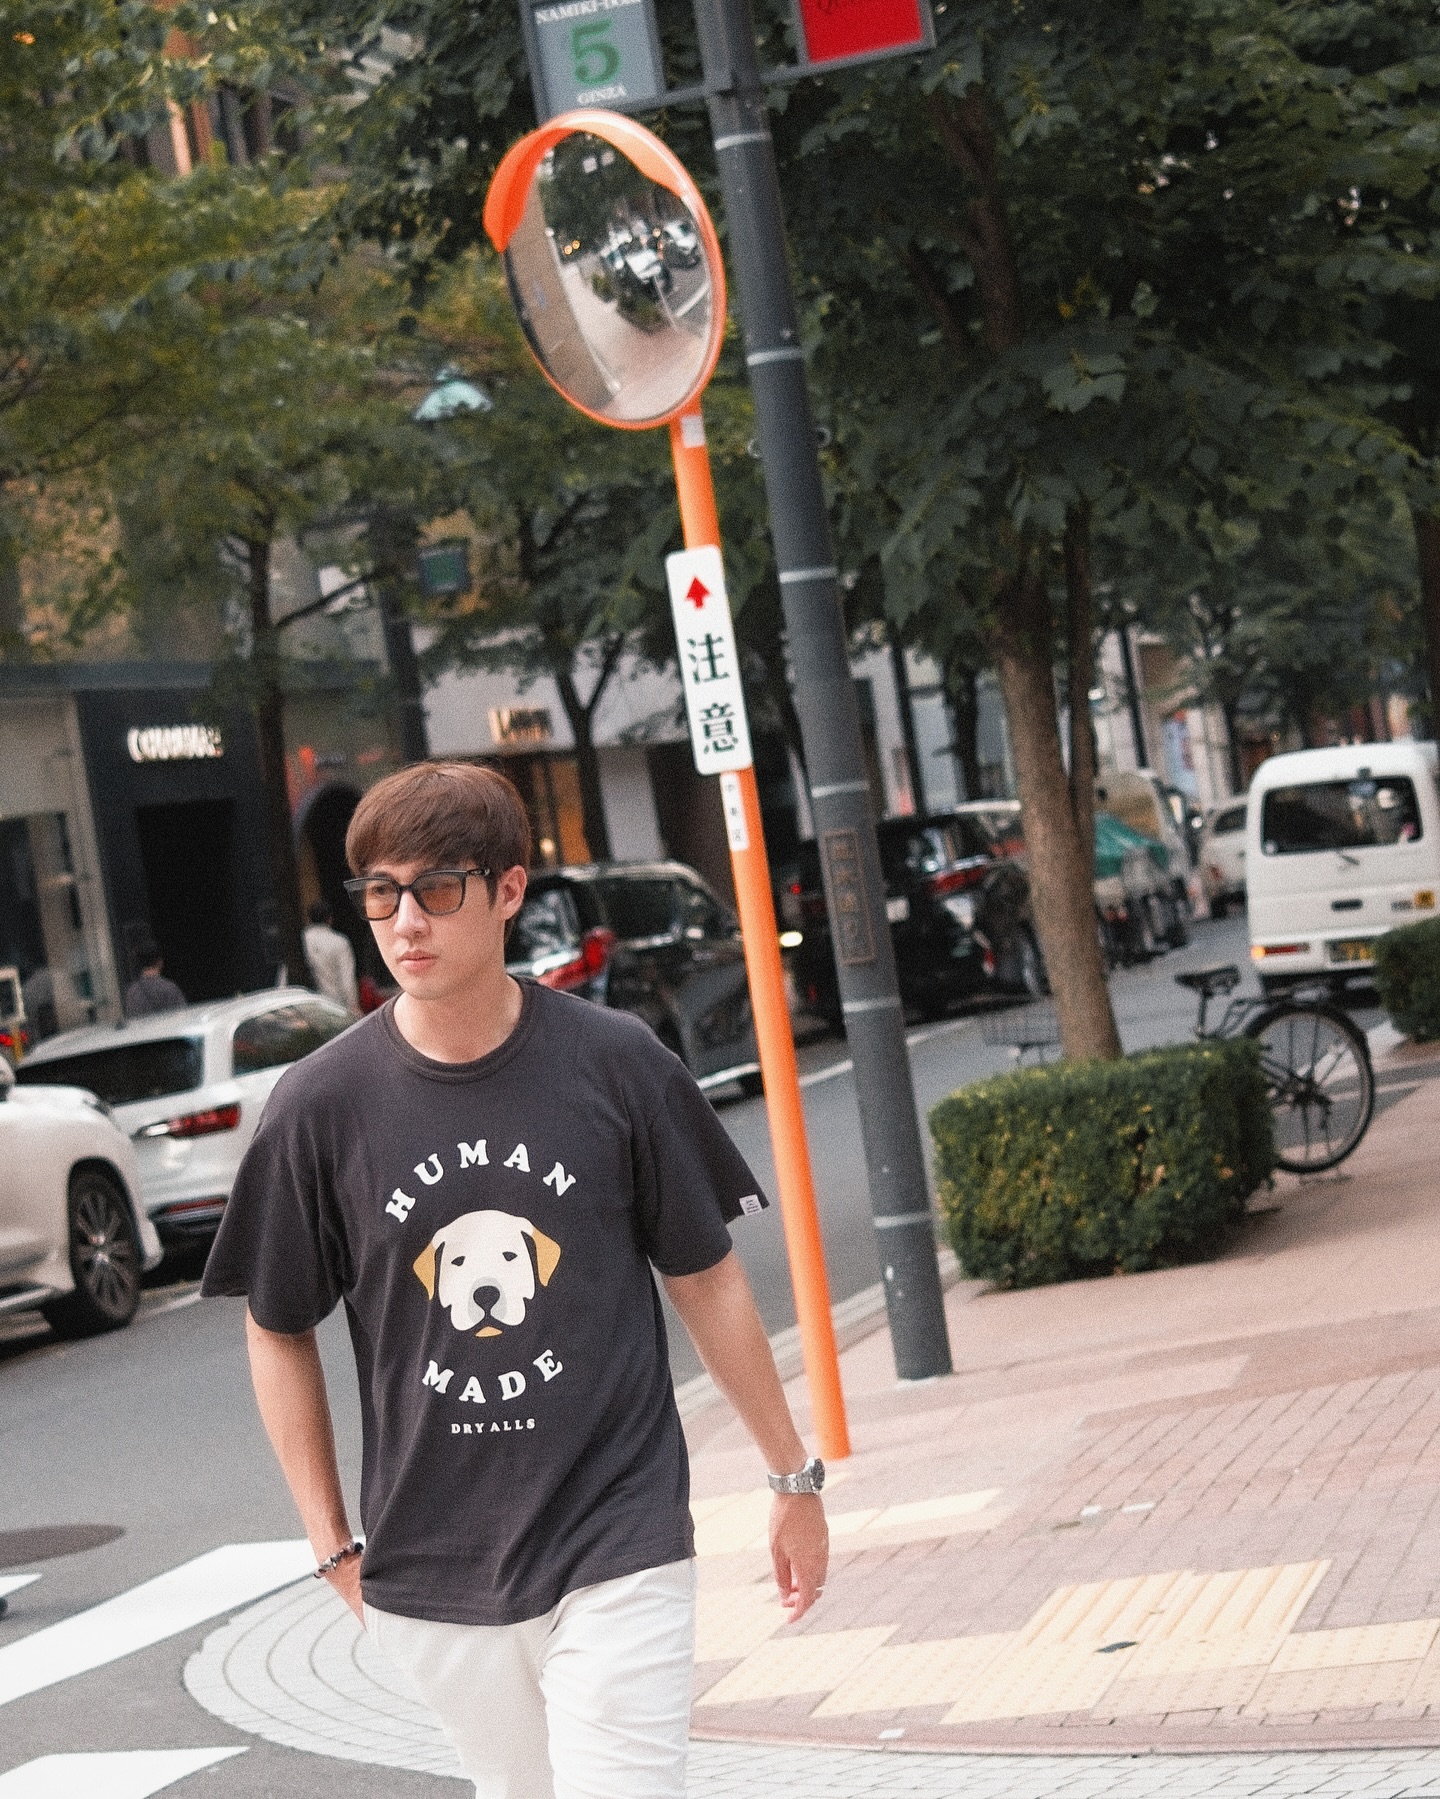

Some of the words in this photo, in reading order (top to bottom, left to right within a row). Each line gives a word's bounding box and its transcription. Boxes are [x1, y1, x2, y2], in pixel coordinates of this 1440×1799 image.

[570, 19, 621, 86] 5
[576, 84, 627, 104] GINZA
[686, 632, 739, 755] 注意
[385, 1139, 576, 1223] HUMAN
[421, 1349, 563, 1404] MADE
[450, 1421, 485, 1435] DRY
[488, 1417, 537, 1433] ALLS
